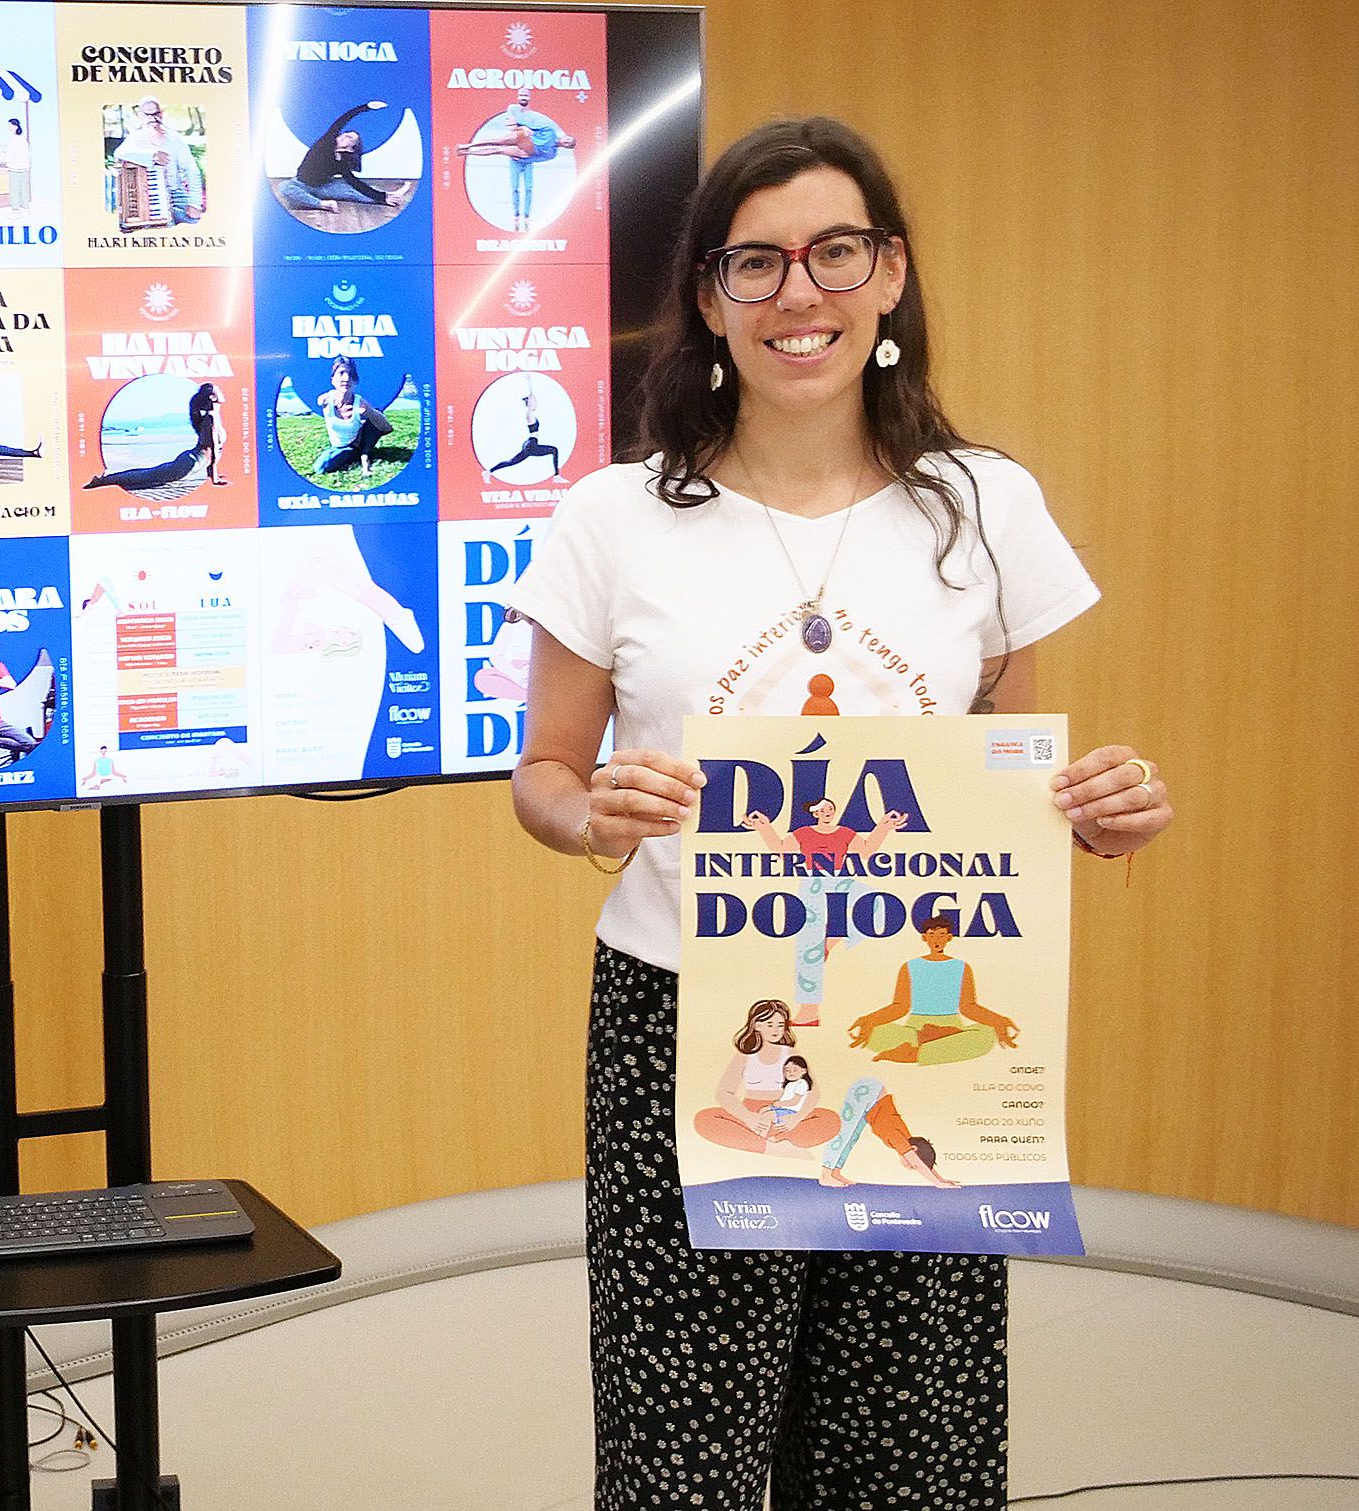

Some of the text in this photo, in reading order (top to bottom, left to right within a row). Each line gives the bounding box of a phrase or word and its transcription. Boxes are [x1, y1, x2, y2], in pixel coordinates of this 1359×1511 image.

[81, 46, 223, 64] CONCIERTO
[329, 41, 398, 62] IOGA
[71, 65, 233, 84] DE MANTRAS
[447, 68, 592, 90] ACROIOGA
[88, 236, 227, 248] HARI KIRTAN DAS
[14, 313, 51, 331] DA
[292, 315, 399, 338] HATHA
[100, 331, 219, 357] HATHA
[308, 336, 384, 359] IOGA
[455, 326, 591, 350] VINYASA
[485, 348, 563, 373] IOGA
[44, 506, 57, 517] M
[717, 659, 749, 694] paz
[834, 609, 853, 632] no
[860, 628, 909, 675] tengo
[695, 732, 932, 833] DÍA
[694, 853, 1020, 877] INTERNACIONAL
[695, 892, 1023, 938] DO IOGA
[998, 1083, 1013, 1091] DO
[1001, 1100, 1044, 1109] CANDO?
[980, 1136, 1008, 1144] PARA
[943, 1152, 978, 1161] TODOS
[980, 1152, 994, 1161] OS
[713, 1201, 771, 1217] Myriam
[978, 1205, 1050, 1229] floow
